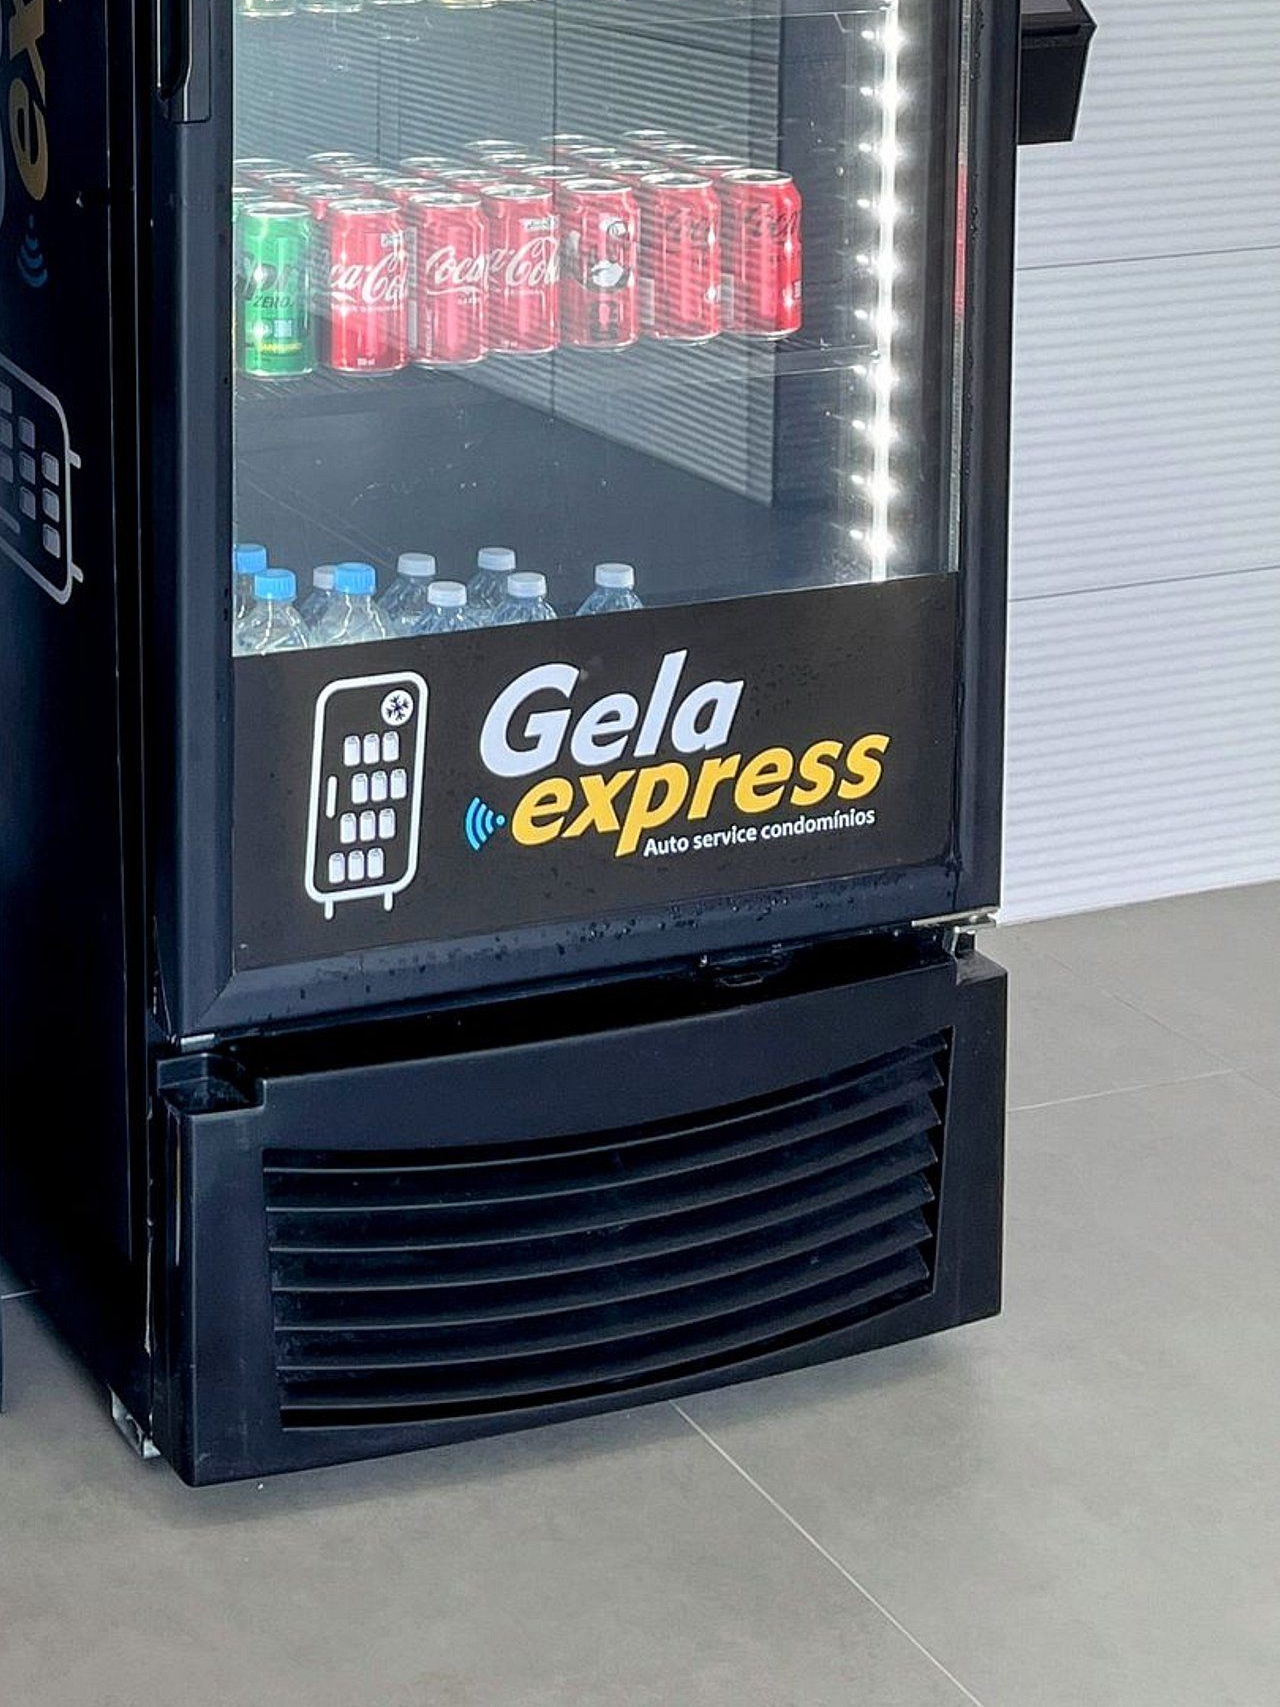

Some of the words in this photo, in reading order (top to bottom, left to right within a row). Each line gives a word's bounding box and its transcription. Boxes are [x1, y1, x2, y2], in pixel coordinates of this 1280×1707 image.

[478, 648, 745, 779] Gela
[510, 732, 891, 859] express
[643, 837, 690, 858] Auto
[693, 825, 758, 851] service
[760, 808, 877, 841] condomínios
